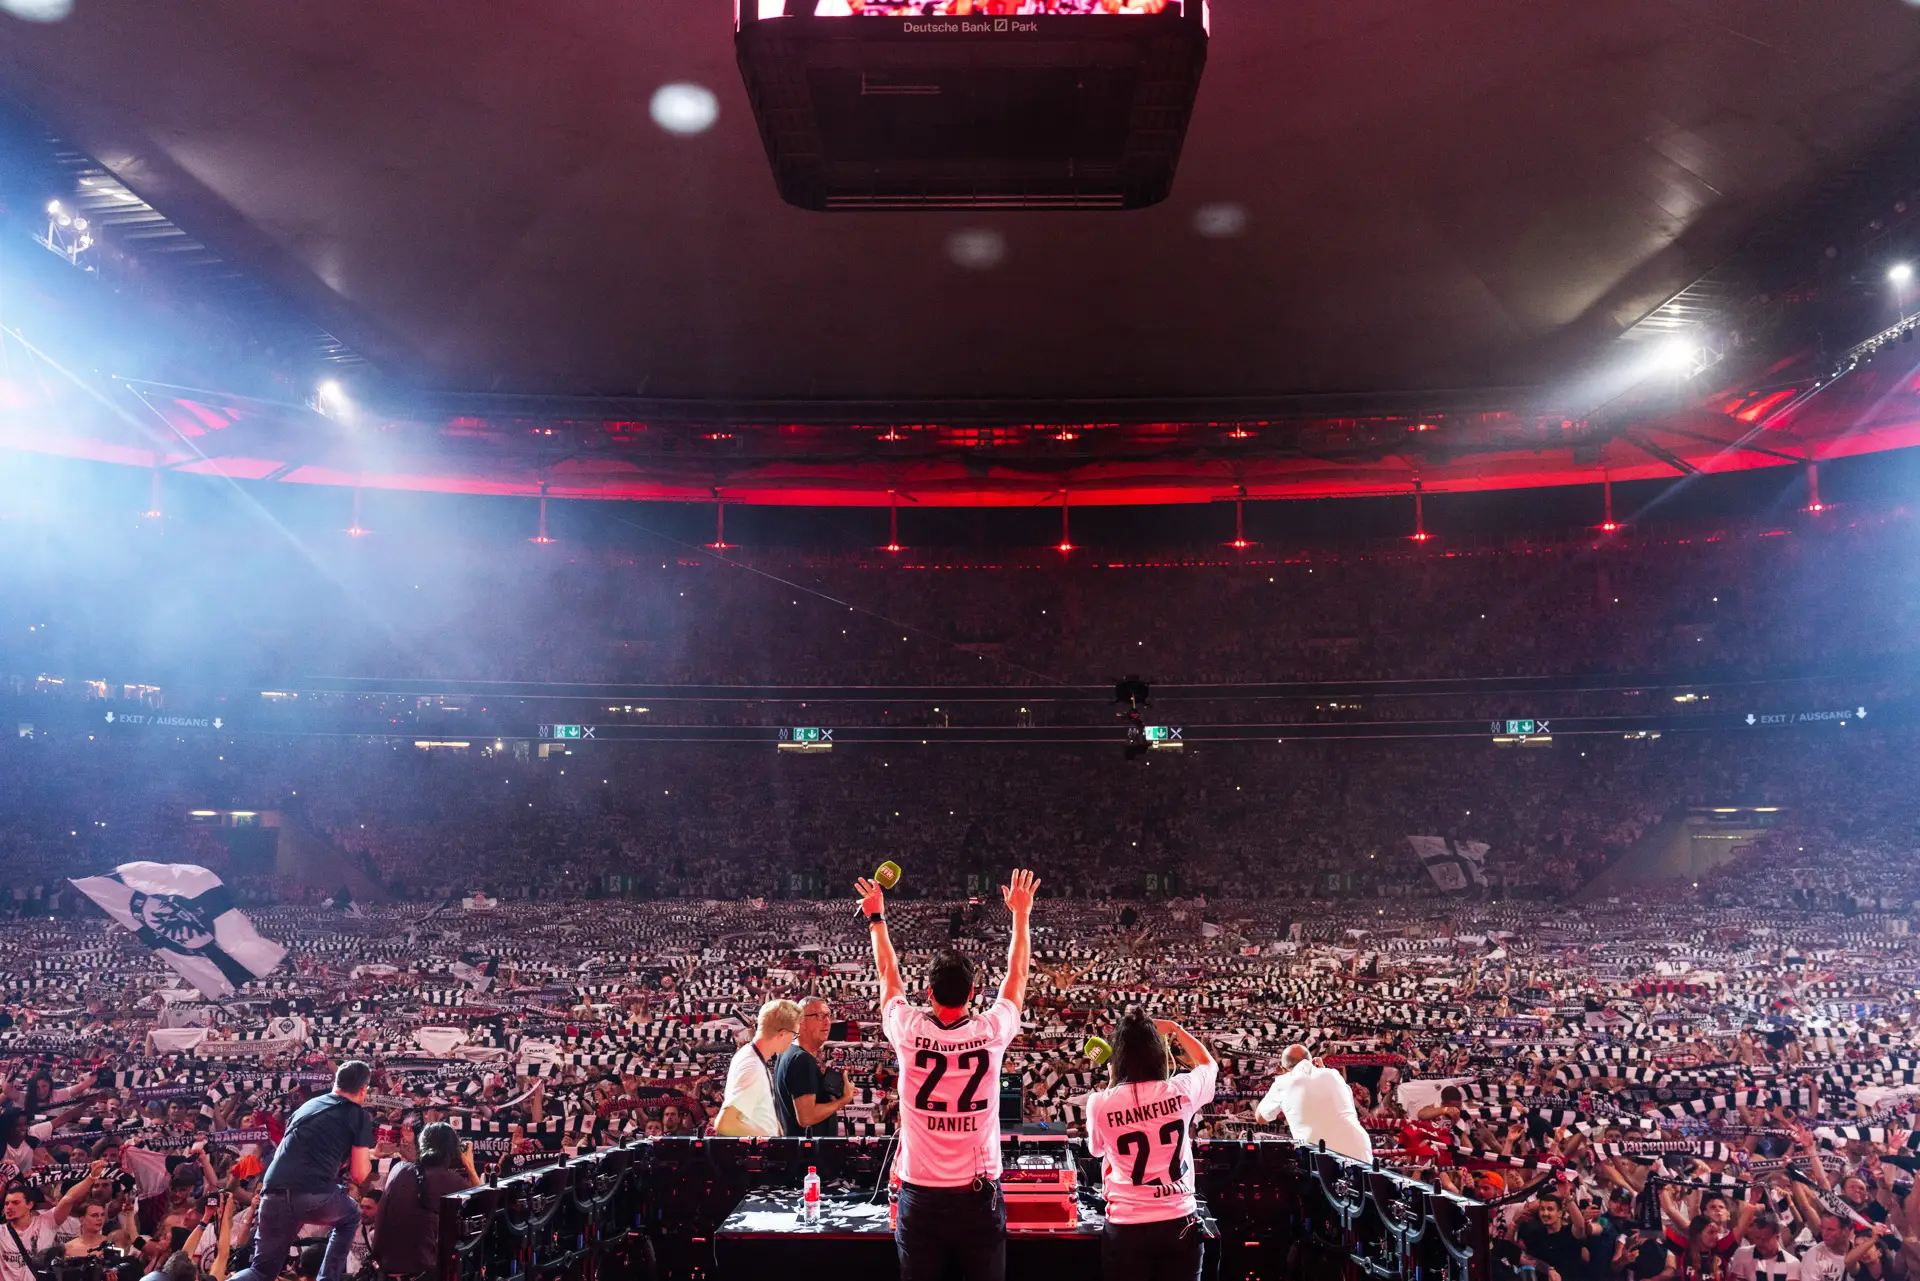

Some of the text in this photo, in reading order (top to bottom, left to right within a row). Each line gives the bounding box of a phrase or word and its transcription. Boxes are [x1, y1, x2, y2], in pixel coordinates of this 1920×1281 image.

[903, 21, 1038, 33] Deutsche Bank Park
[119, 714, 144, 724] EXIT
[156, 716, 209, 727] AUSGANG
[1761, 714, 1787, 724] EXIT
[1799, 710, 1852, 721] AUSGANG
[880, 866, 894, 879] FFH
[914, 1048, 990, 1113] 22
[1107, 1095, 1182, 1128] FRANKFURT
[927, 1116, 978, 1132] DANIEL
[214, 1131, 269, 1143] RANGERS
[1622, 1140, 1702, 1156] Krombacher
